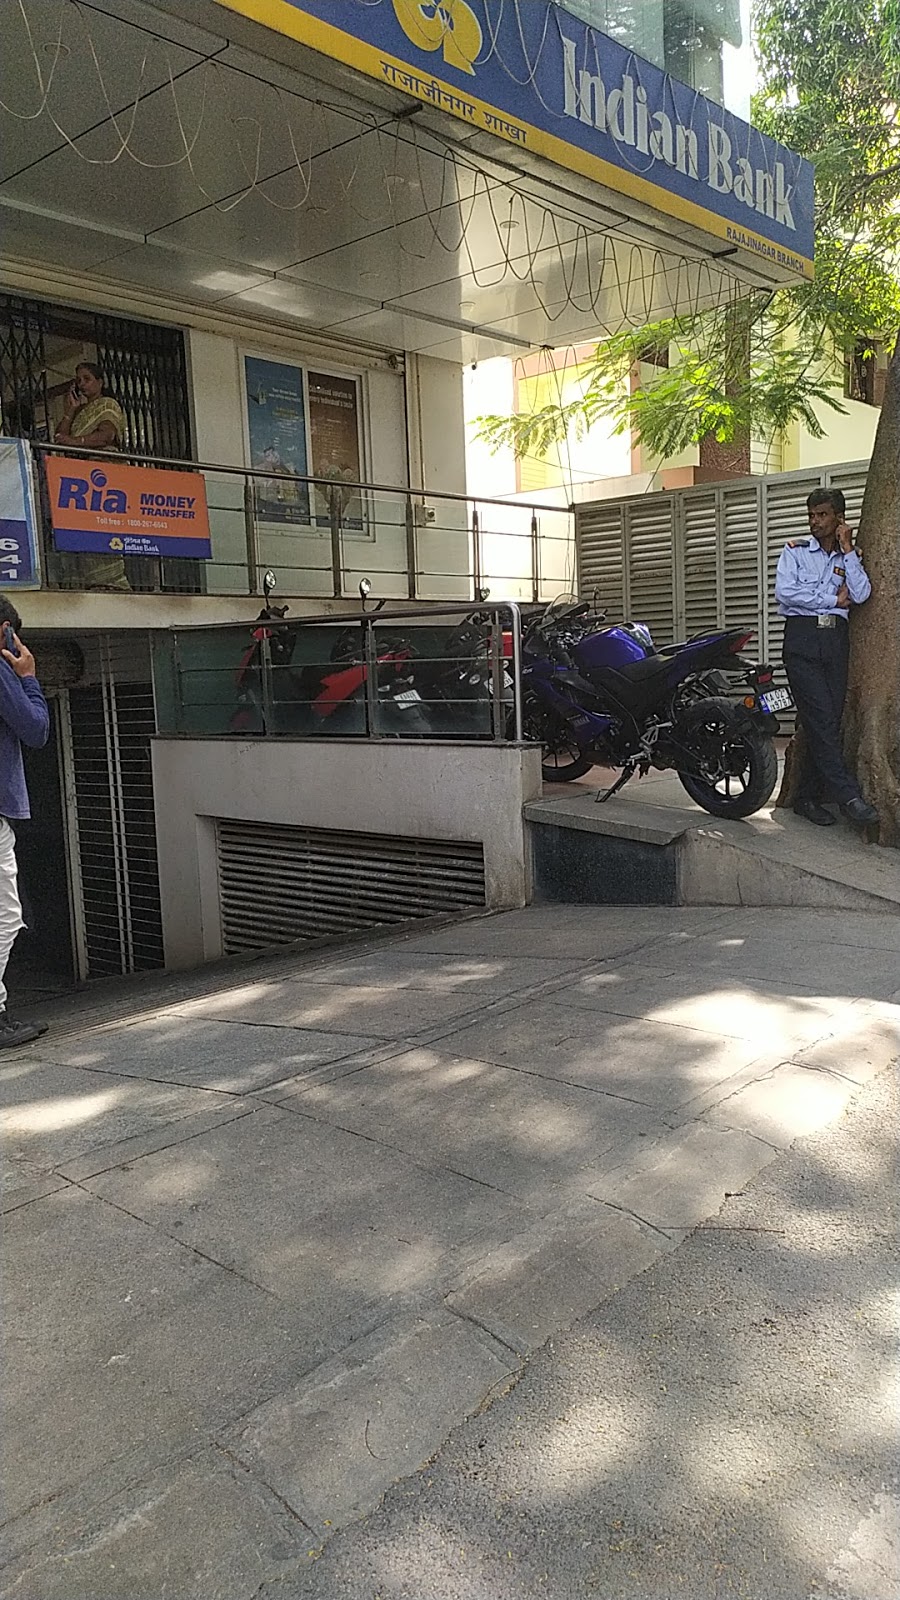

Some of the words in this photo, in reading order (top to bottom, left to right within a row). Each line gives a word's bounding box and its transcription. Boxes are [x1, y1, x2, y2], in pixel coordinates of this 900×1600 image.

[380, 60, 477, 120] राजाजीनगर
[483, 111, 527, 144] शाखा
[563, 35, 699, 181] Indian
[707, 120, 796, 231] Bank
[726, 227, 776, 260] RAJAJINAGAR
[777, 251, 804, 272] BRANCH
[57, 469, 128, 514] Ria
[140, 493, 196, 509] MONEY
[96, 516, 107, 525] Toll
[140, 507, 195, 520] TRANSFER
[124, 543, 143, 551] Indian
